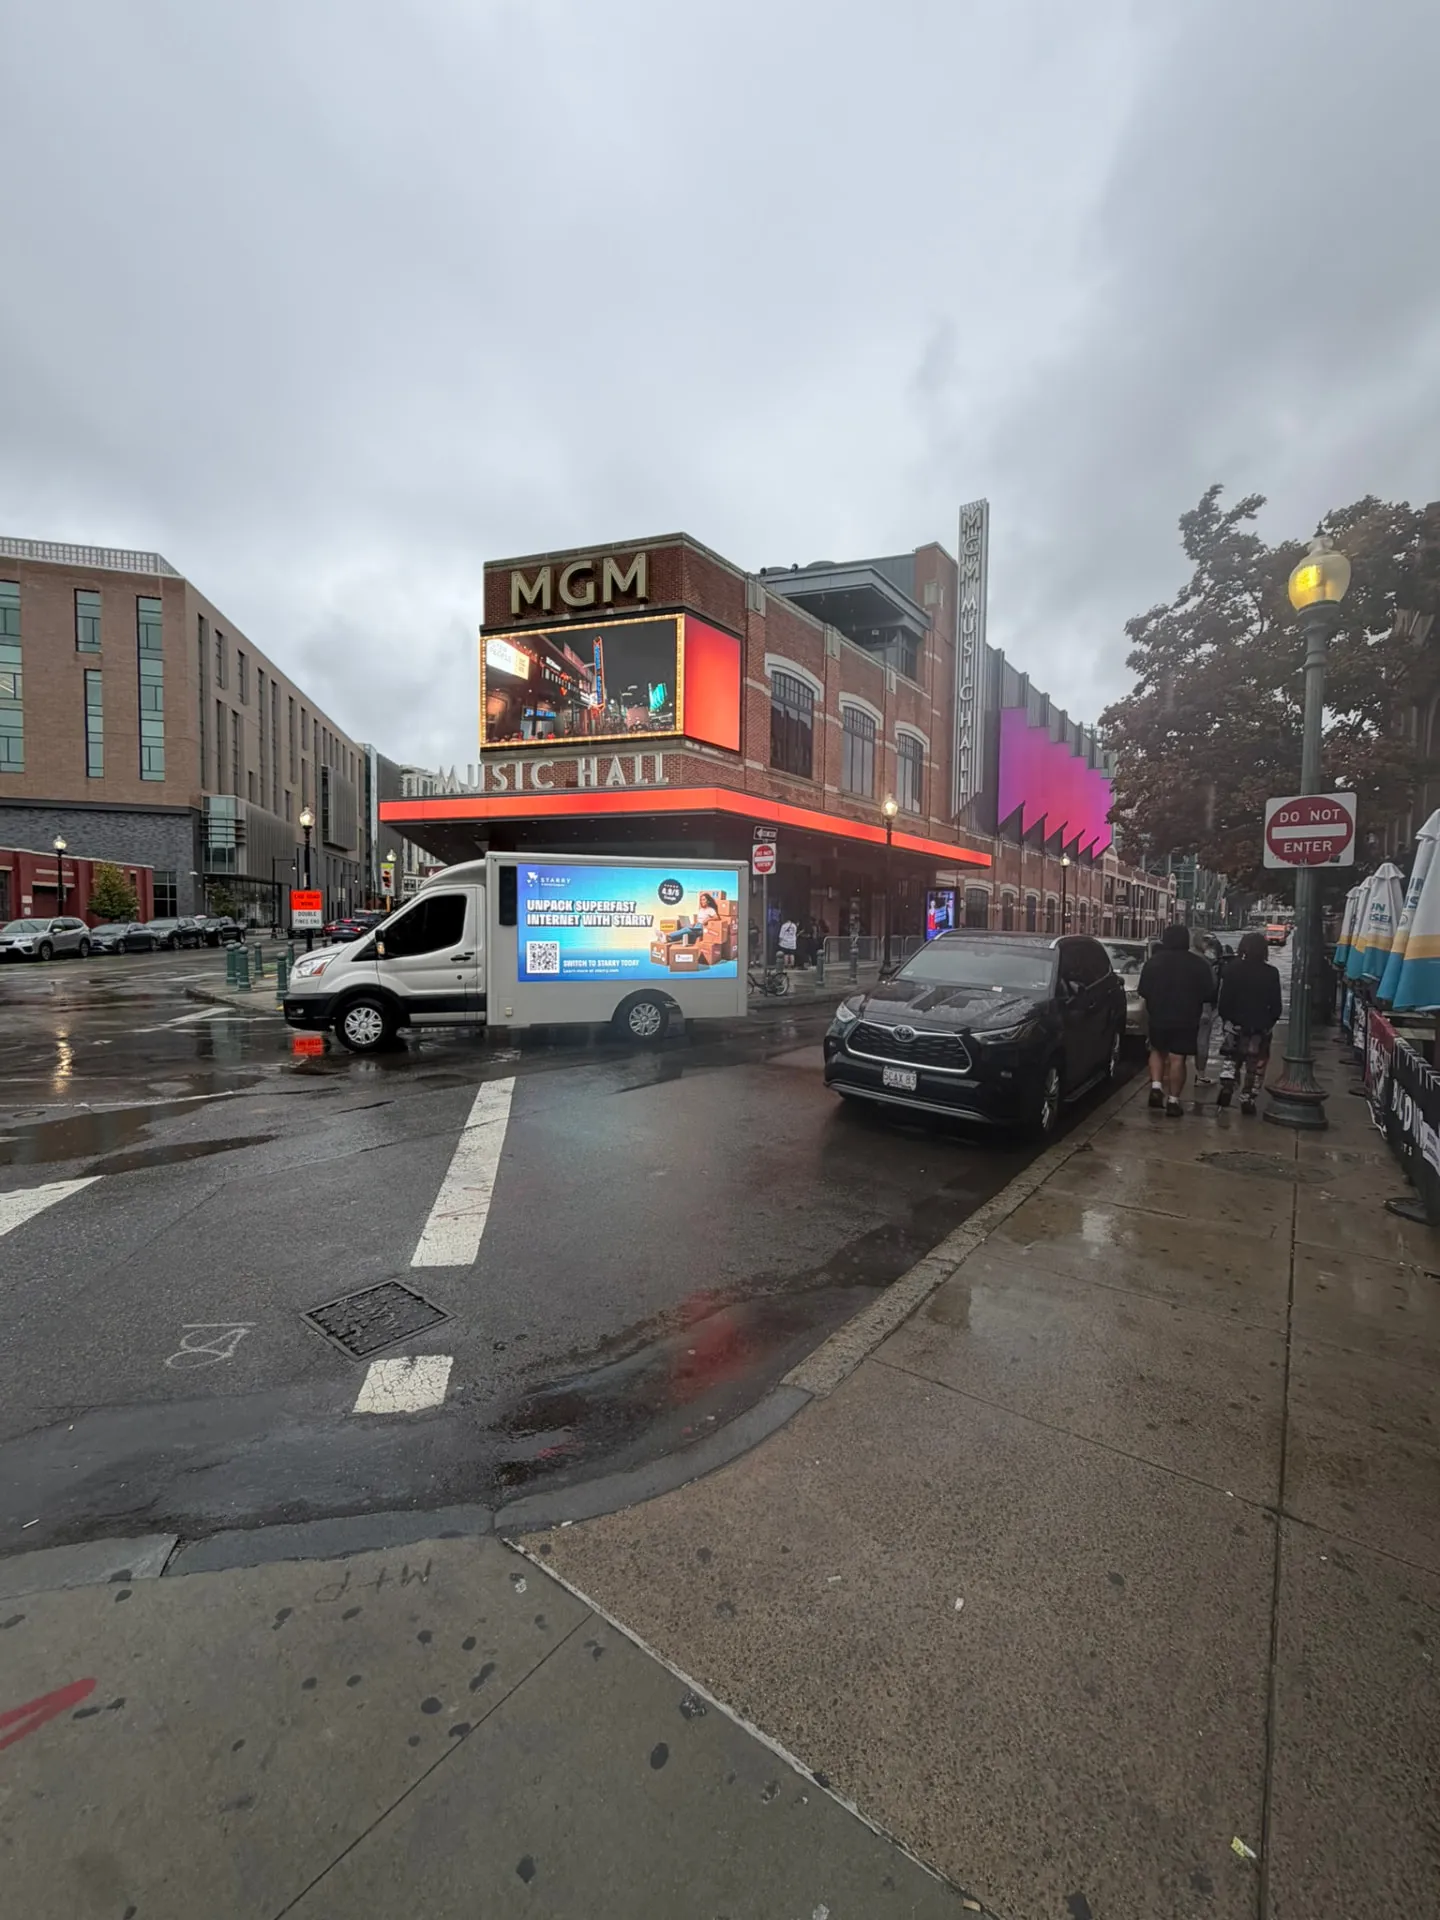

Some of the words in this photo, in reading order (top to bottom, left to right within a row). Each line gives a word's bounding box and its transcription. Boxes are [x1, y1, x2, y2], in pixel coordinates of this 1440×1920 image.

[960, 507, 981, 582] MGM
[511, 552, 647, 614] MGM
[960, 597, 978, 701] MUSIC
[435, 759, 554, 795] MUSIC
[577, 752, 669, 787] HALL
[959, 710, 973, 794] HALL
[1280, 811, 1300, 823] DO
[1310, 808, 1341, 821] NOT
[1283, 840, 1332, 853] ENTER
[527, 900, 574, 912] UNPACK
[575, 901, 637, 913] SUPERFAST
[527, 914, 581, 927] INTERNET
[582, 914, 612, 927] WITH
[613, 915, 654, 927] STARRY
